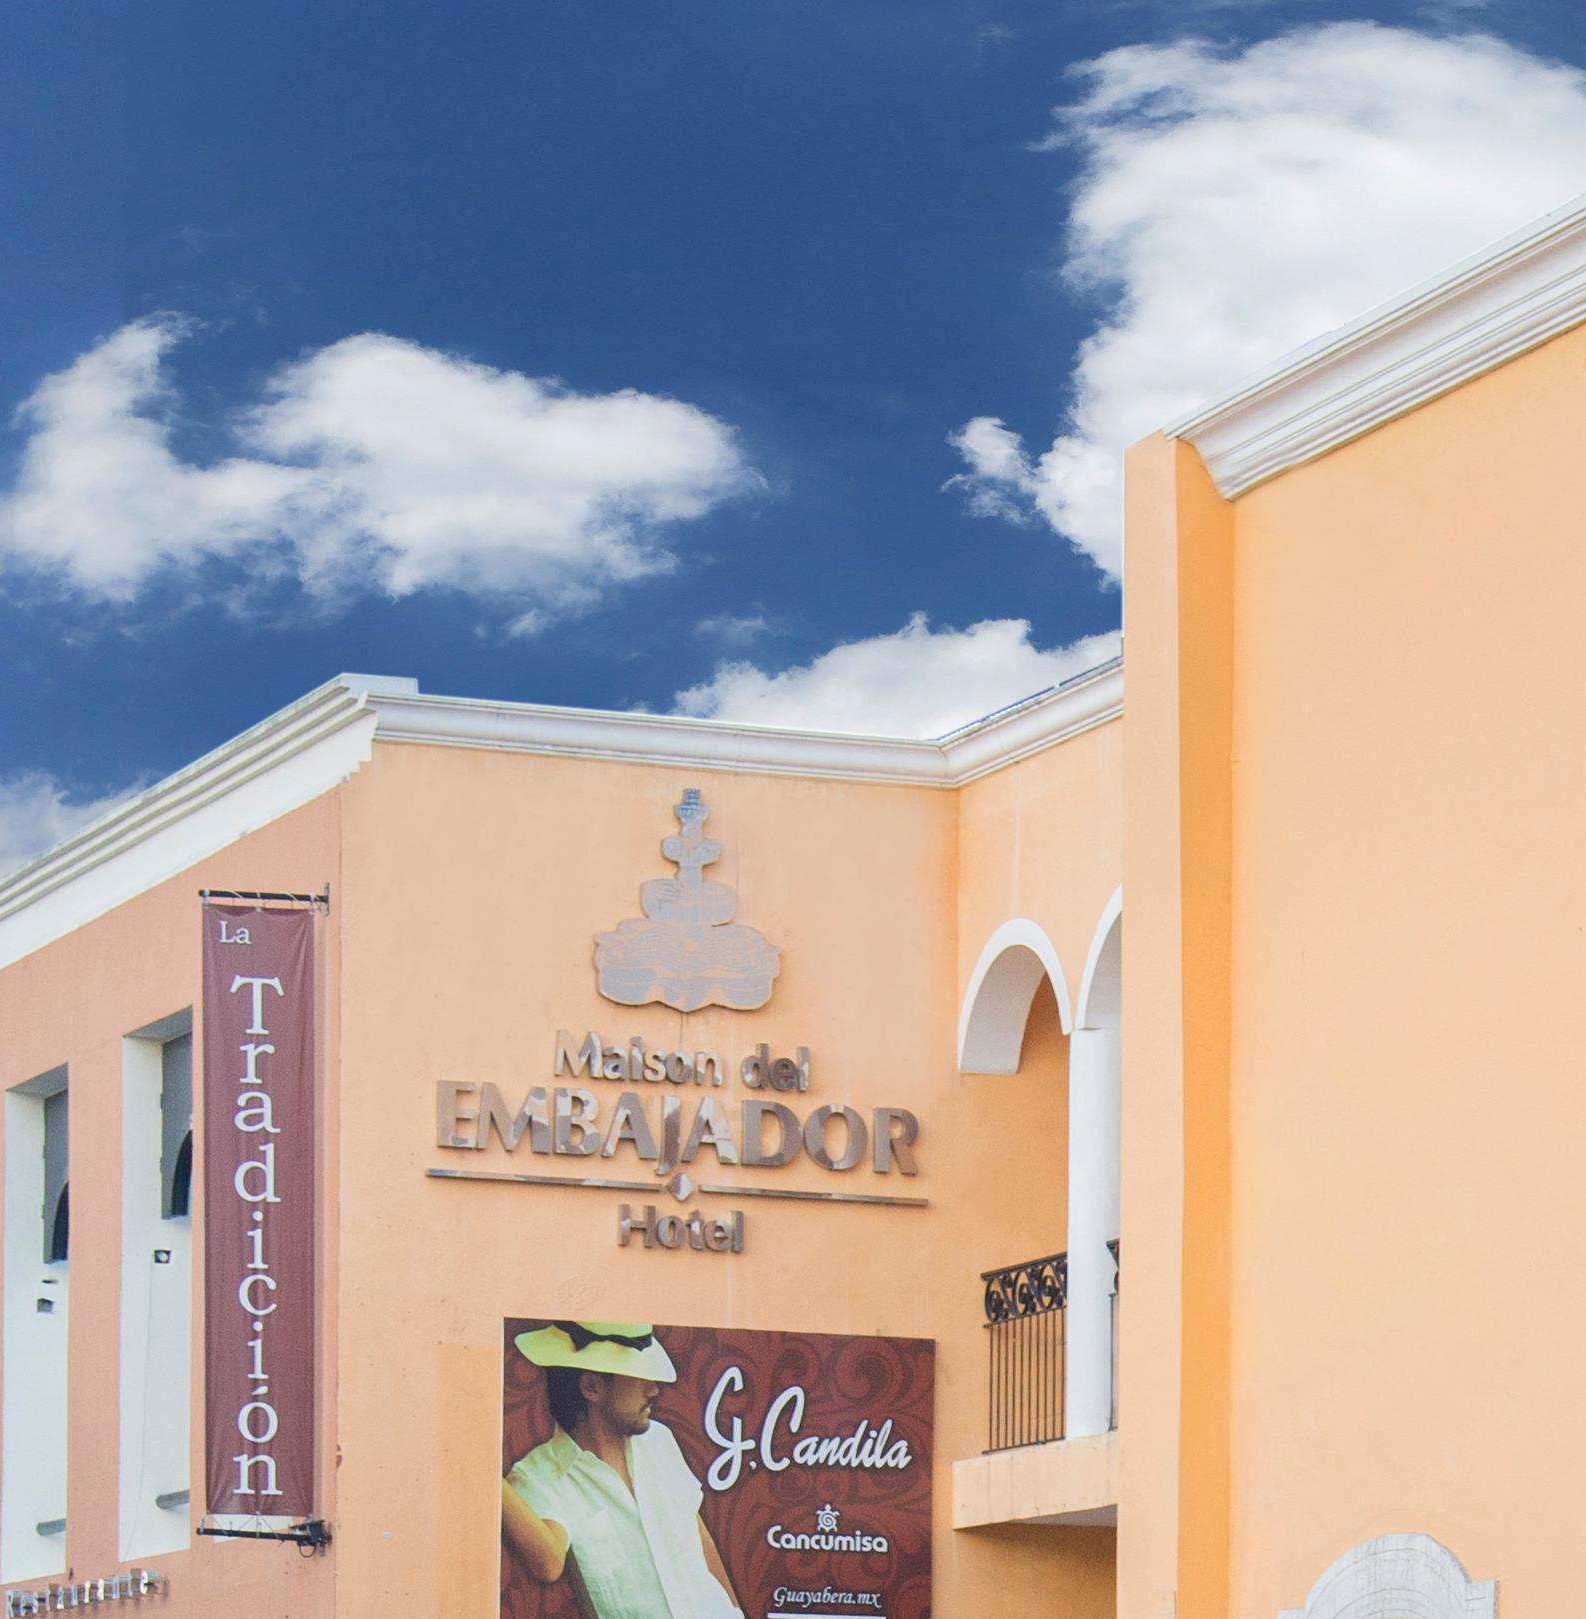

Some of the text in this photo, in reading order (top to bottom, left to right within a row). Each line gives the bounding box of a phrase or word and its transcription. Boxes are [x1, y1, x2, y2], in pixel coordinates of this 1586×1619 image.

[219, 919, 252, 945] La
[554, 1029, 811, 1094] Maison del
[435, 1079, 920, 1176] EMBAJADOR
[229, 974, 285, 1497] Tradición
[617, 1203, 746, 1254] Hotel
[767, 1525, 888, 1553] Cancumisa
[6, 1569, 158, 1619] Restaurante
[773, 1586, 883, 1609] Guayabera.mx
